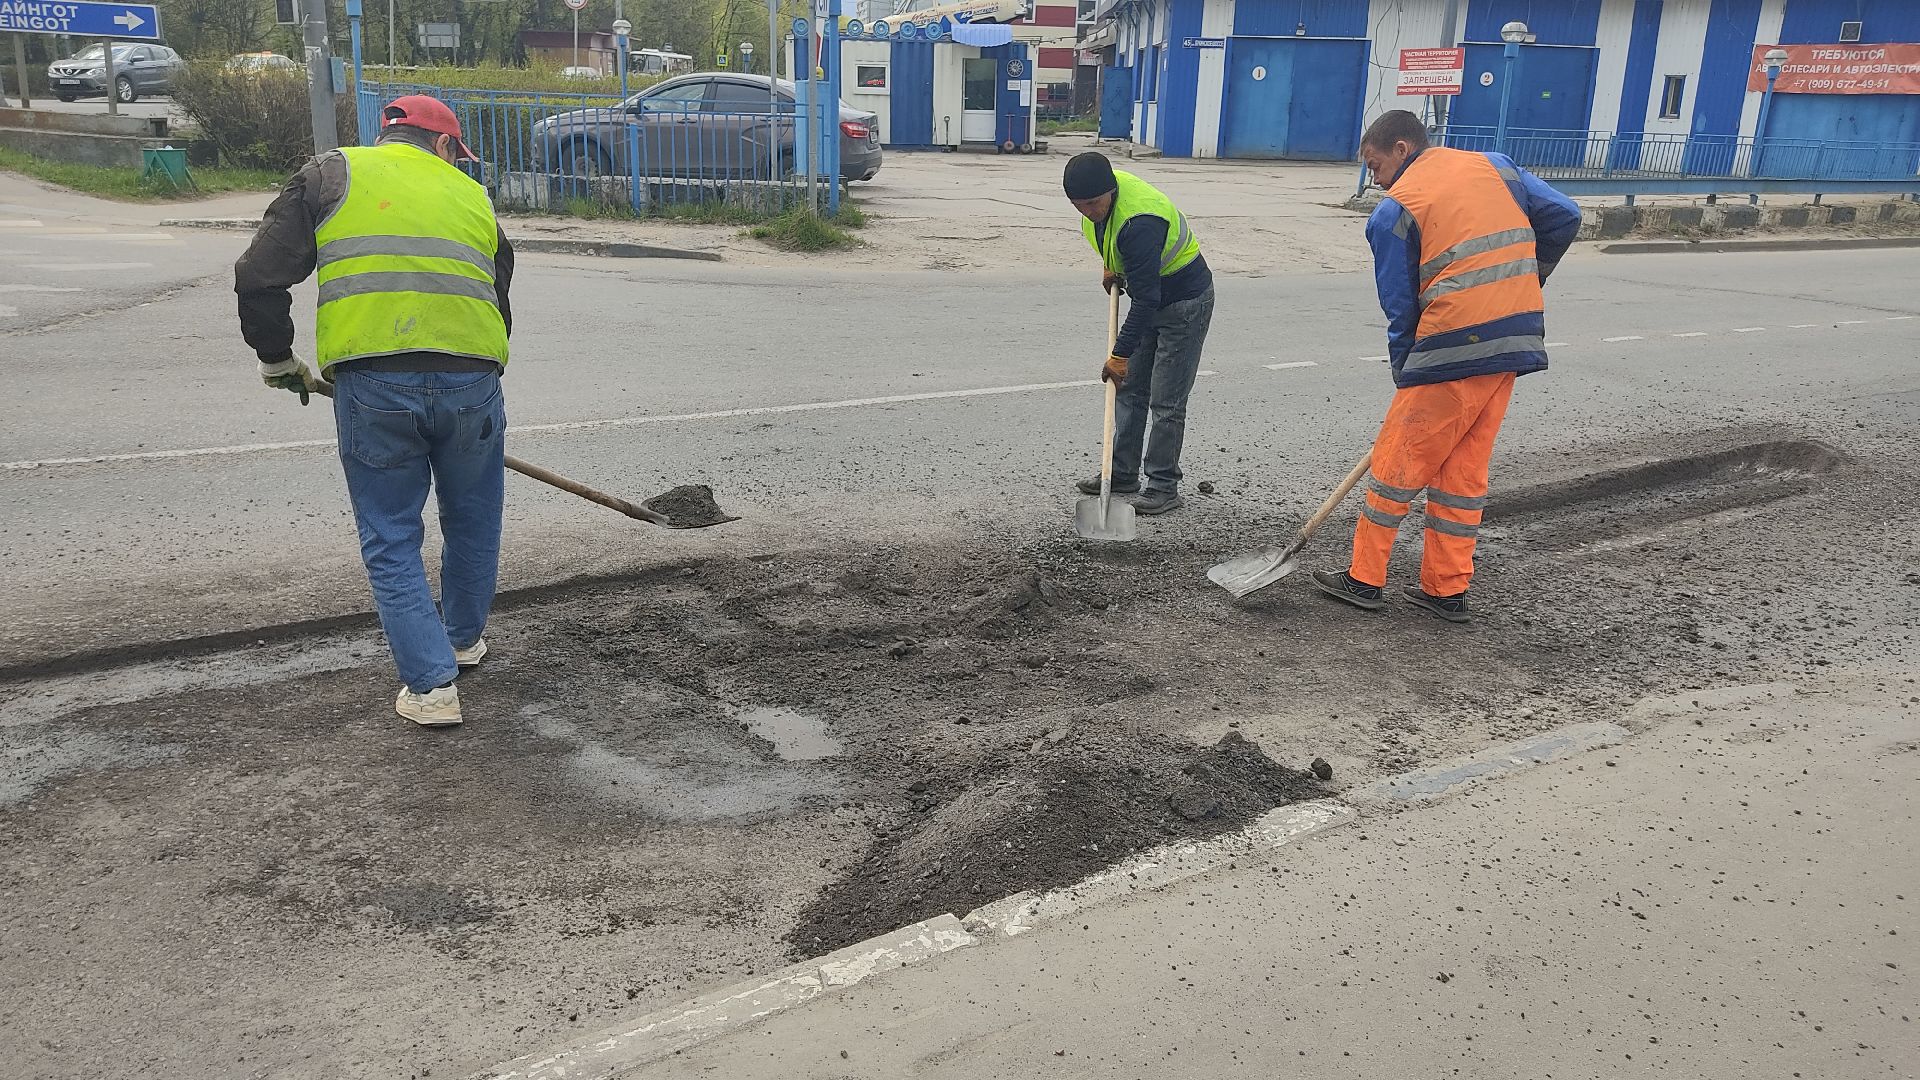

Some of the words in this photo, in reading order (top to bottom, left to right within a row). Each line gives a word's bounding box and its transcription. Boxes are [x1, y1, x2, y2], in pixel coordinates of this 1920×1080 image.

[0, 0, 78, 18] АЙНГОТ
[0, 15, 70, 30] EINGOT
[1811, 49, 1885, 60] ТРЕБУЮТСЯ
[1755, 64, 1829, 74] АВСЛЕСАРИ
[1832, 64, 1841, 74] И
[1403, 75, 1453, 84] ЗАПРЕЩЕНА
[1484, 74, 1490, 83] 2
[1793, 80, 1806, 88] +7
[1808, 79, 1834, 90] (909)
[1836, 79, 1889, 89] 677-49-51
